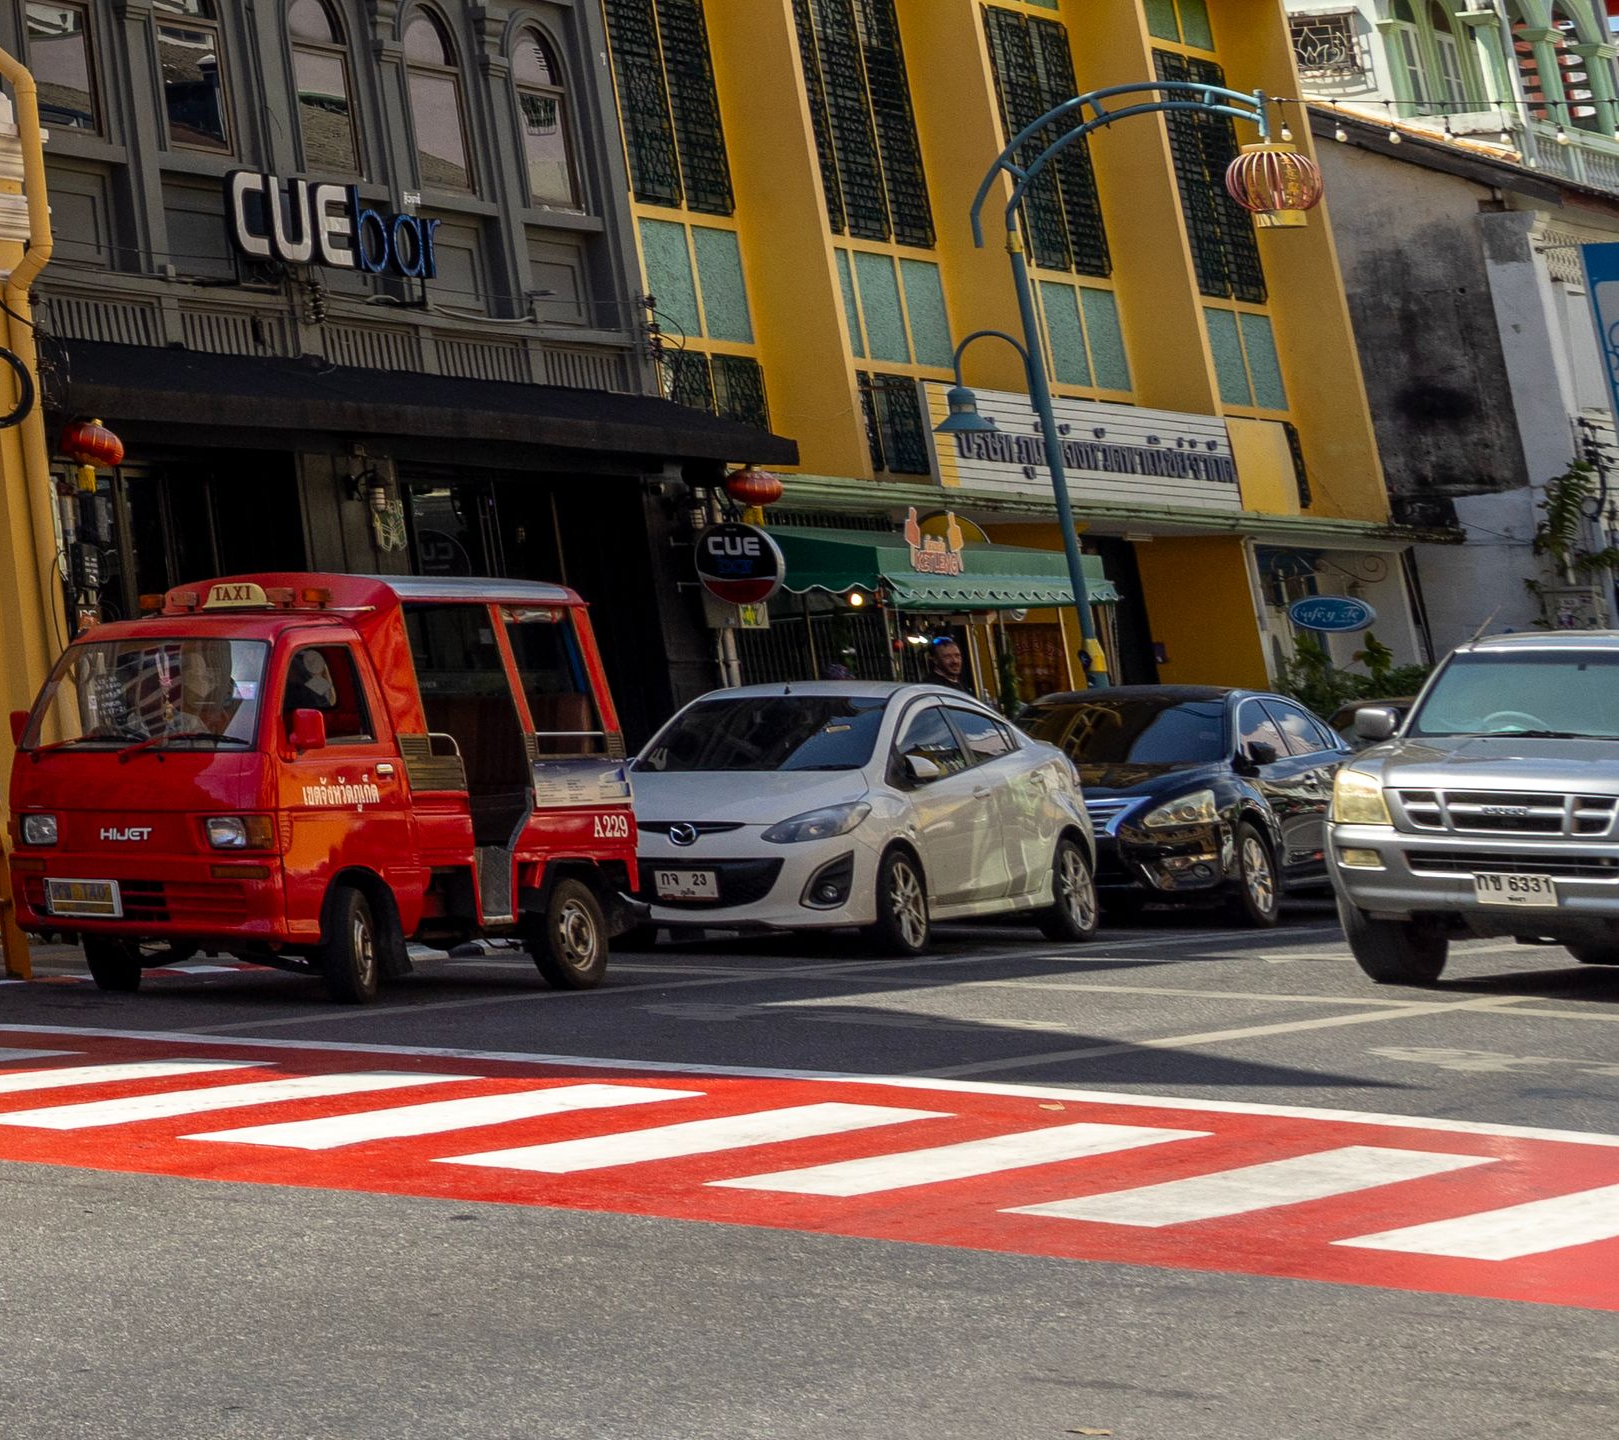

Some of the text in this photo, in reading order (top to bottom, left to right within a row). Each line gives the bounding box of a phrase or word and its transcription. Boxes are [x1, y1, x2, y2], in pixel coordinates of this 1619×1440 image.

[707, 536, 760, 556] CUE
[213, 585, 251, 601] TAXI
[100, 828, 152, 841] HIJET
[594, 815, 629, 838] A229
[692, 873, 707, 886] 23
[1508, 876, 1552, 893] 6331
